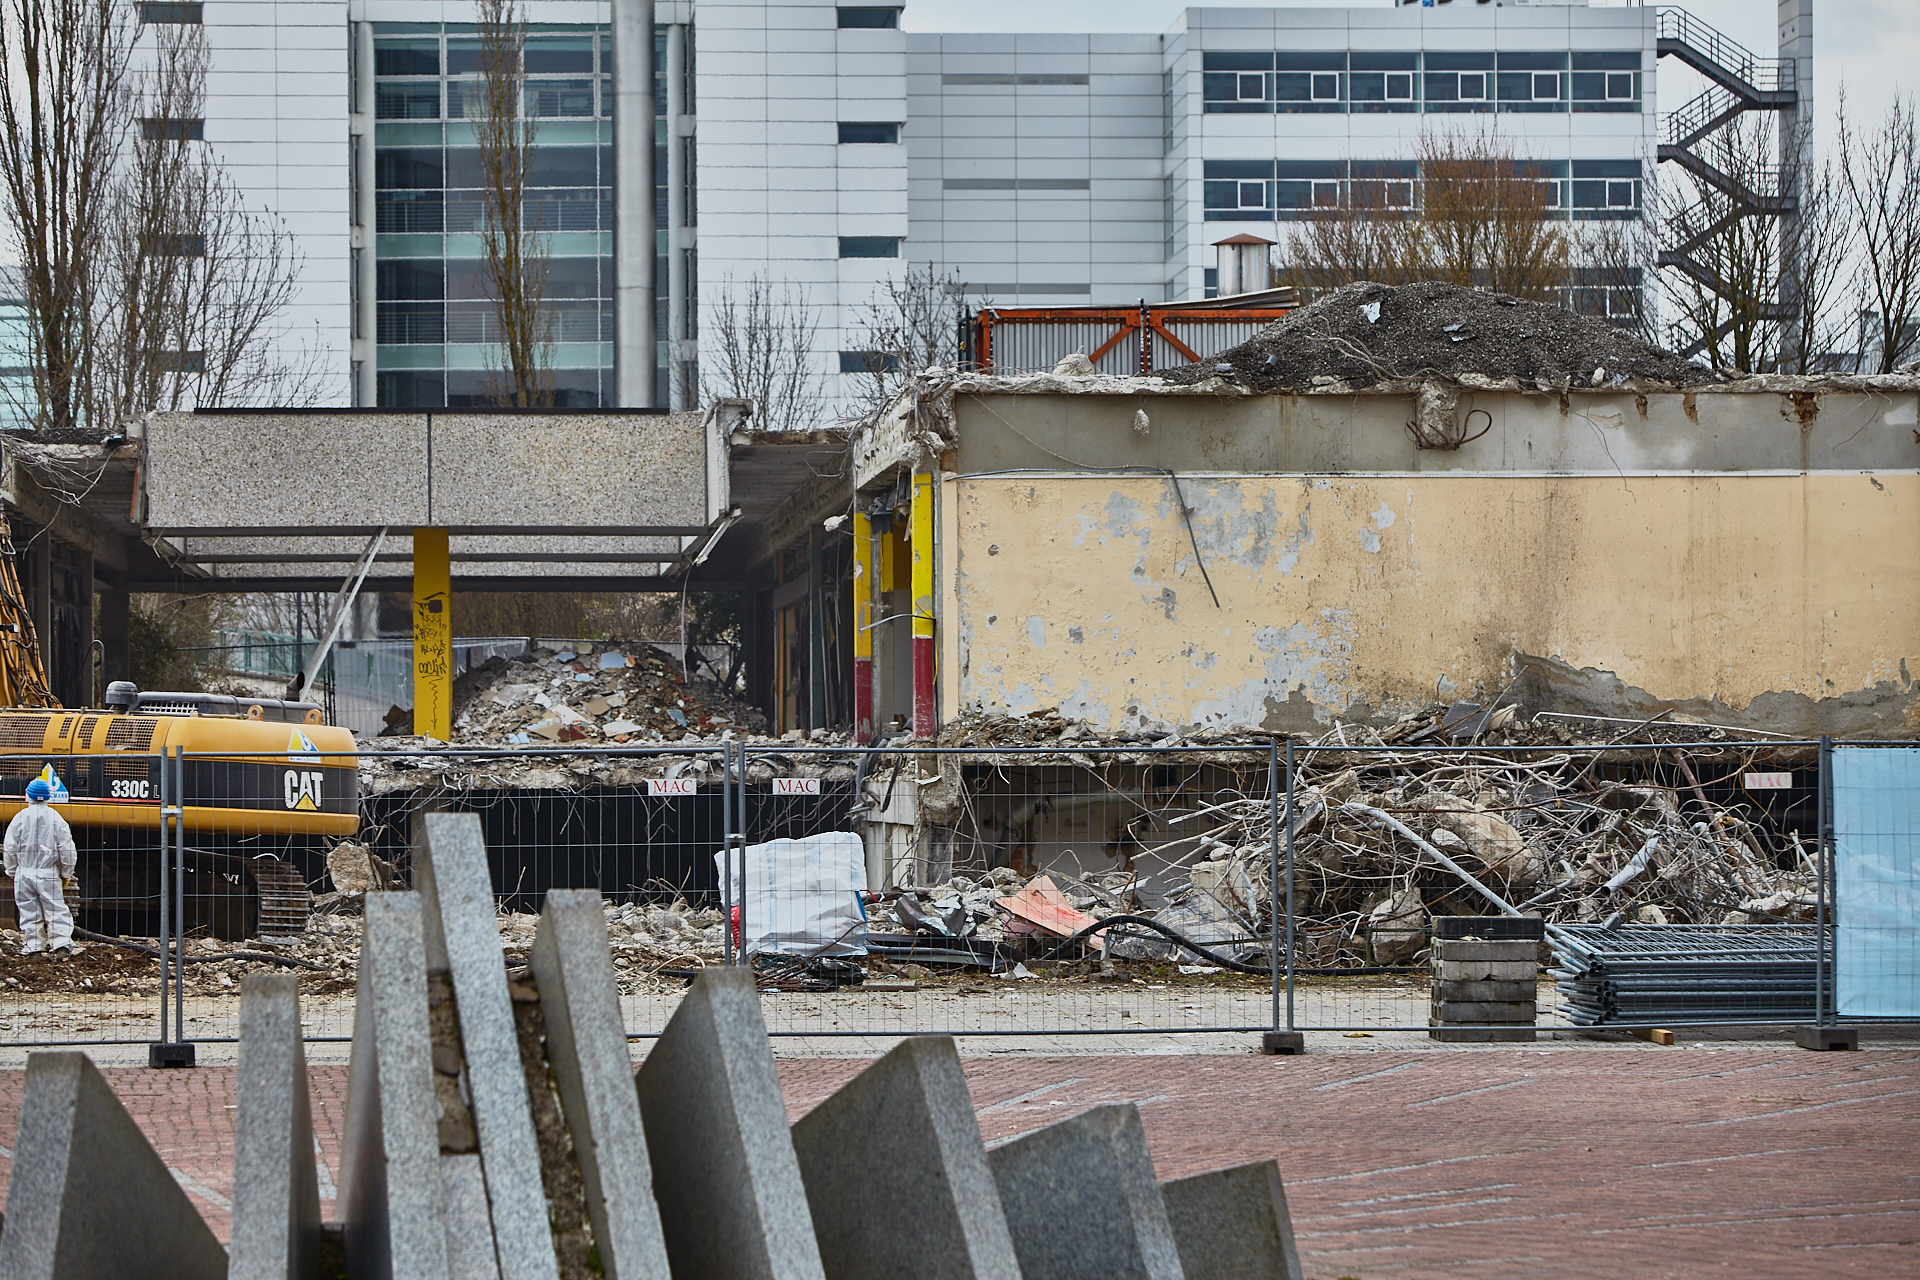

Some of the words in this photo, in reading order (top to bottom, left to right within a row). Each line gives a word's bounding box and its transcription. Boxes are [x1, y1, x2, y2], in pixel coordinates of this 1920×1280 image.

[653, 779, 693, 793] MAC
[778, 779, 817, 793] MAC
[1748, 774, 1788, 788] MAC
[111, 779, 150, 799] 330C
[153, 784, 160, 799] L
[284, 769, 323, 809] CAT
